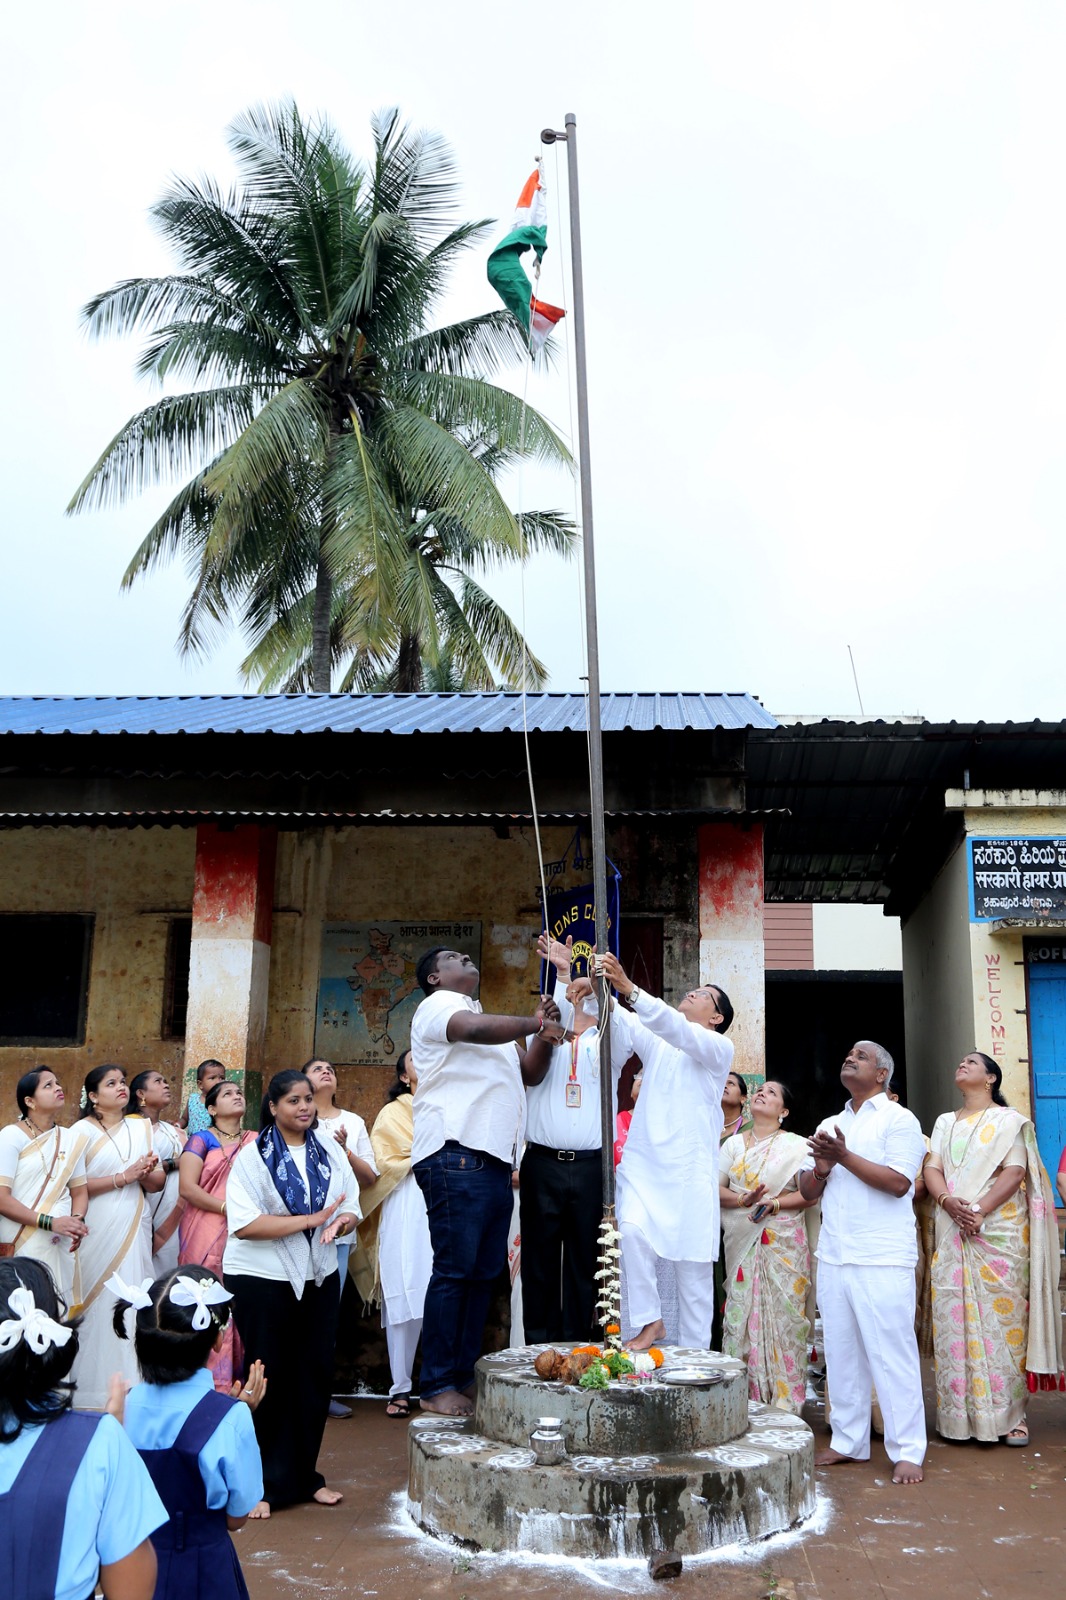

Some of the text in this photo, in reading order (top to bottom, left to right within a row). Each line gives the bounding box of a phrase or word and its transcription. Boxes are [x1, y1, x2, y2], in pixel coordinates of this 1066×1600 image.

[973, 845, 1017, 865] ಸರಕಾರಿ
[1019, 845, 1056, 864] ಹಿರಿಯ
[975, 865, 1021, 889] सरकारी
[1022, 871, 1054, 892] हायर
[453, 923, 474, 939] देश
[549, 905, 579, 941] IONS
[984, 954, 1006, 1056] WELCOME
